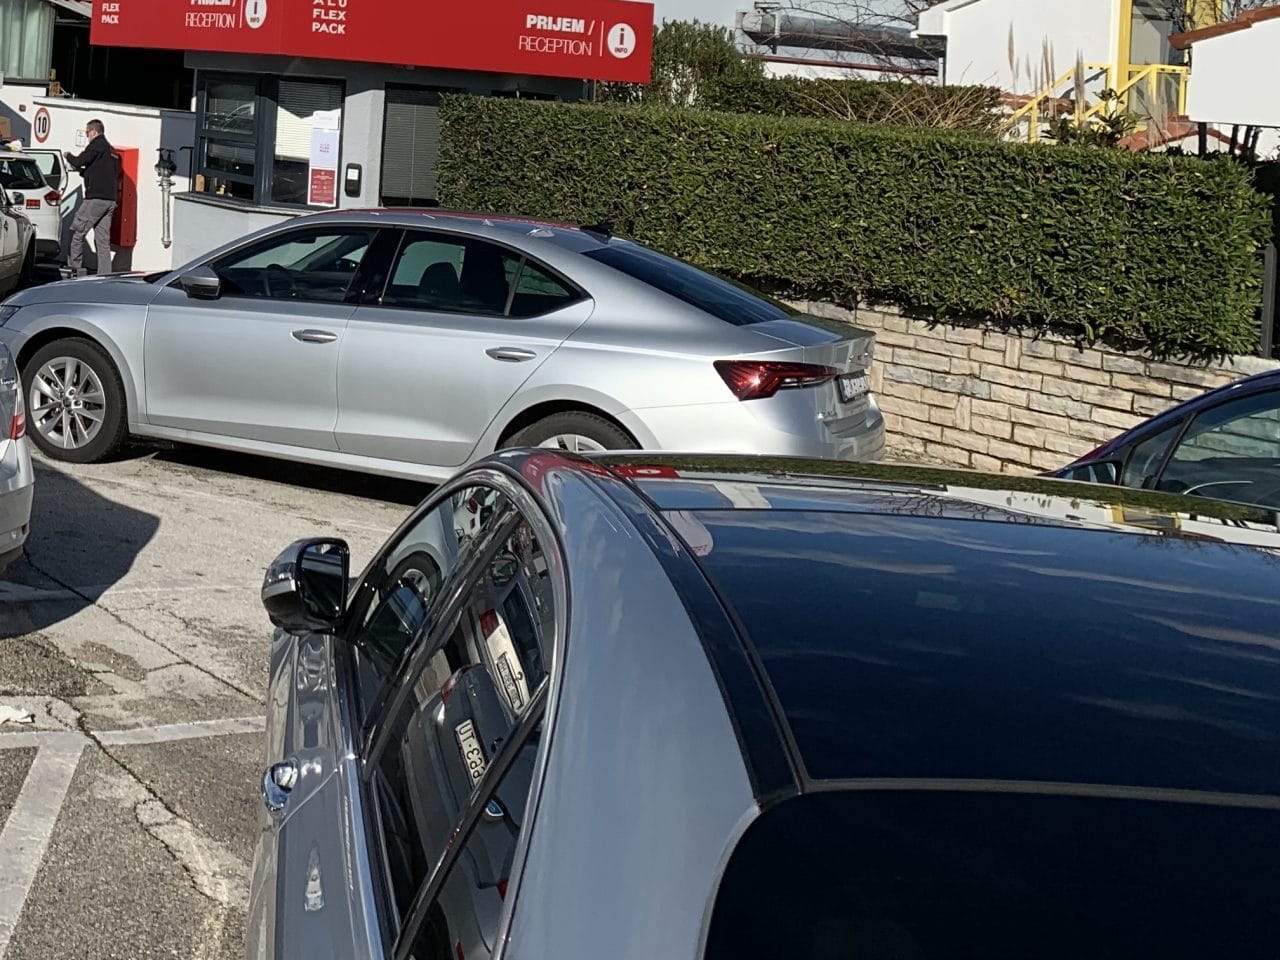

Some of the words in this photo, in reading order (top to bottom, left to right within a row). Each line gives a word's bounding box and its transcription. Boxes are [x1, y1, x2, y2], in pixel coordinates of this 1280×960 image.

[101, 3, 120, 12] FLEX
[312, 8, 346, 21] FLEX
[101, 15, 119, 24] PACK
[185, 12, 235, 29] RECEPTION
[526, 14, 585, 33] PRIJEM
[312, 22, 346, 34] PACK
[518, 35, 593, 56] RECEPTION
[38, 117, 47, 133] 10
